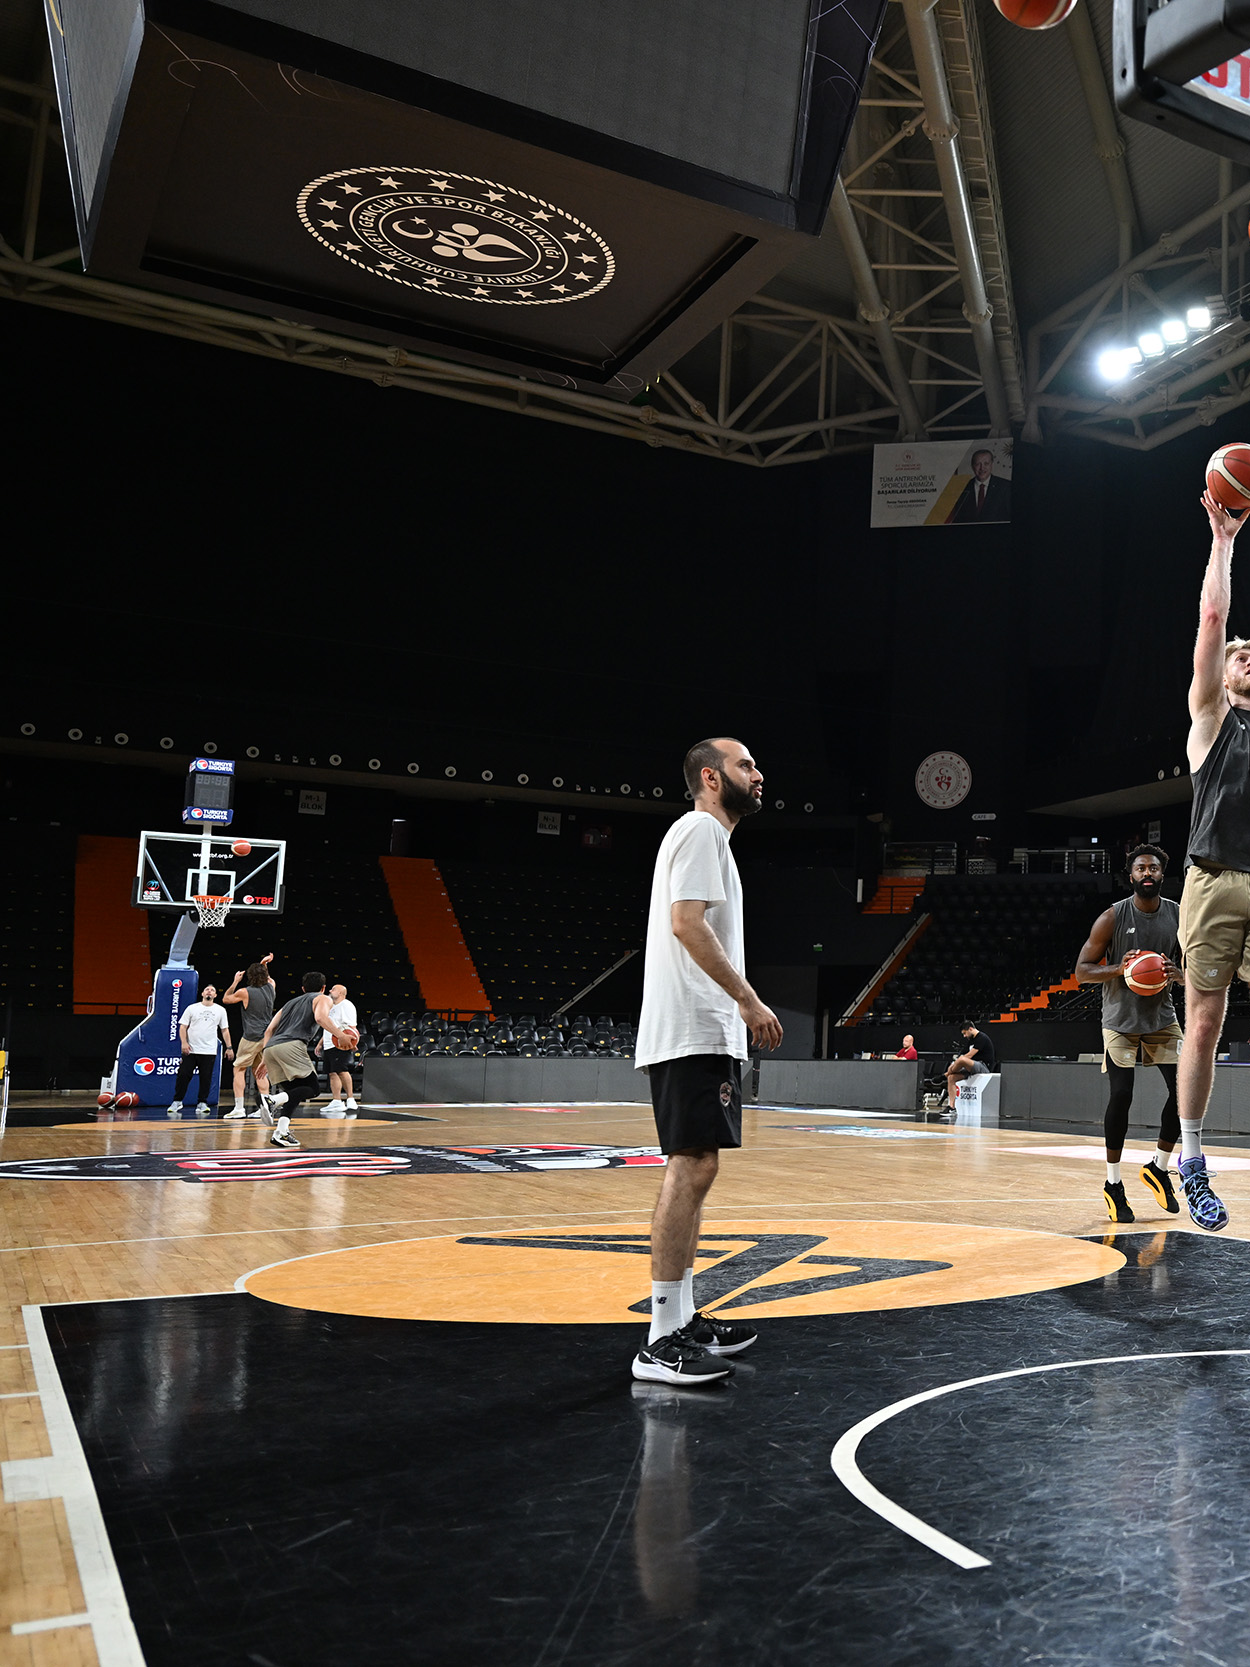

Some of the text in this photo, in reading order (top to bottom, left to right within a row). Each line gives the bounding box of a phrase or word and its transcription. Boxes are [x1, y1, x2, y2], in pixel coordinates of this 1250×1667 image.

[404, 195, 428, 205] VE
[431, 197, 487, 214] SPOR
[254, 897, 274, 905] TBF
